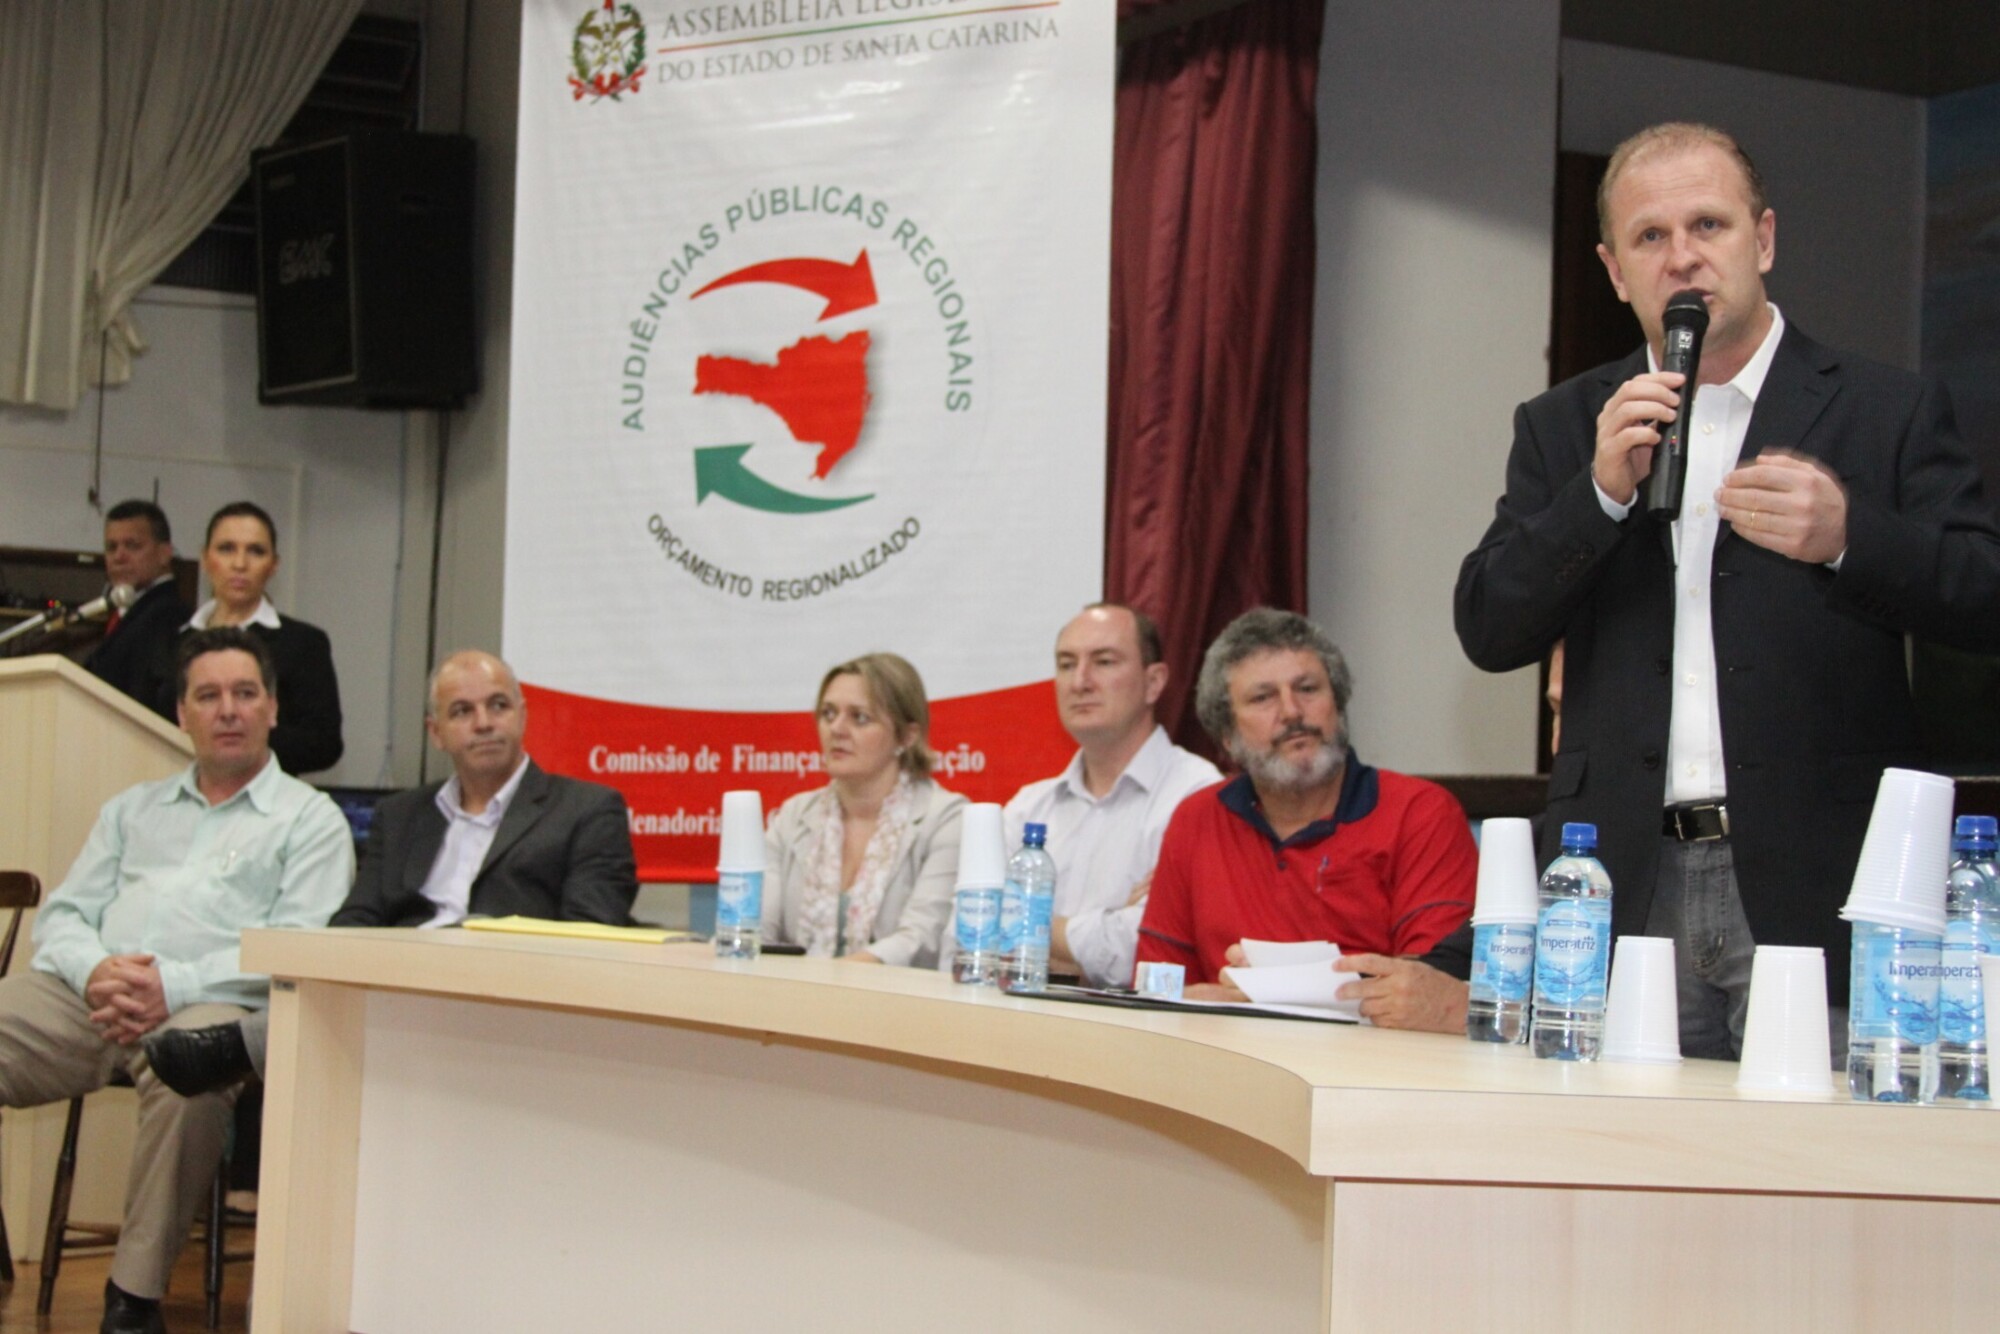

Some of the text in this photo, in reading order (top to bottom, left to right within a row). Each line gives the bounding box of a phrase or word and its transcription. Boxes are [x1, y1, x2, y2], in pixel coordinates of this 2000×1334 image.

[658, 18, 1059, 83] DO ESTADO DE SANTA CATARINA
[622, 185, 974, 431] AUDIÊNCIAS PÚBLICAS REGIONAIS
[647, 514, 920, 600] ORÇAMENTO REGIONALIZADO
[589, 744, 690, 774] Comissão
[694, 744, 721, 773] de
[1541, 936, 1596, 951] Imperatriz
